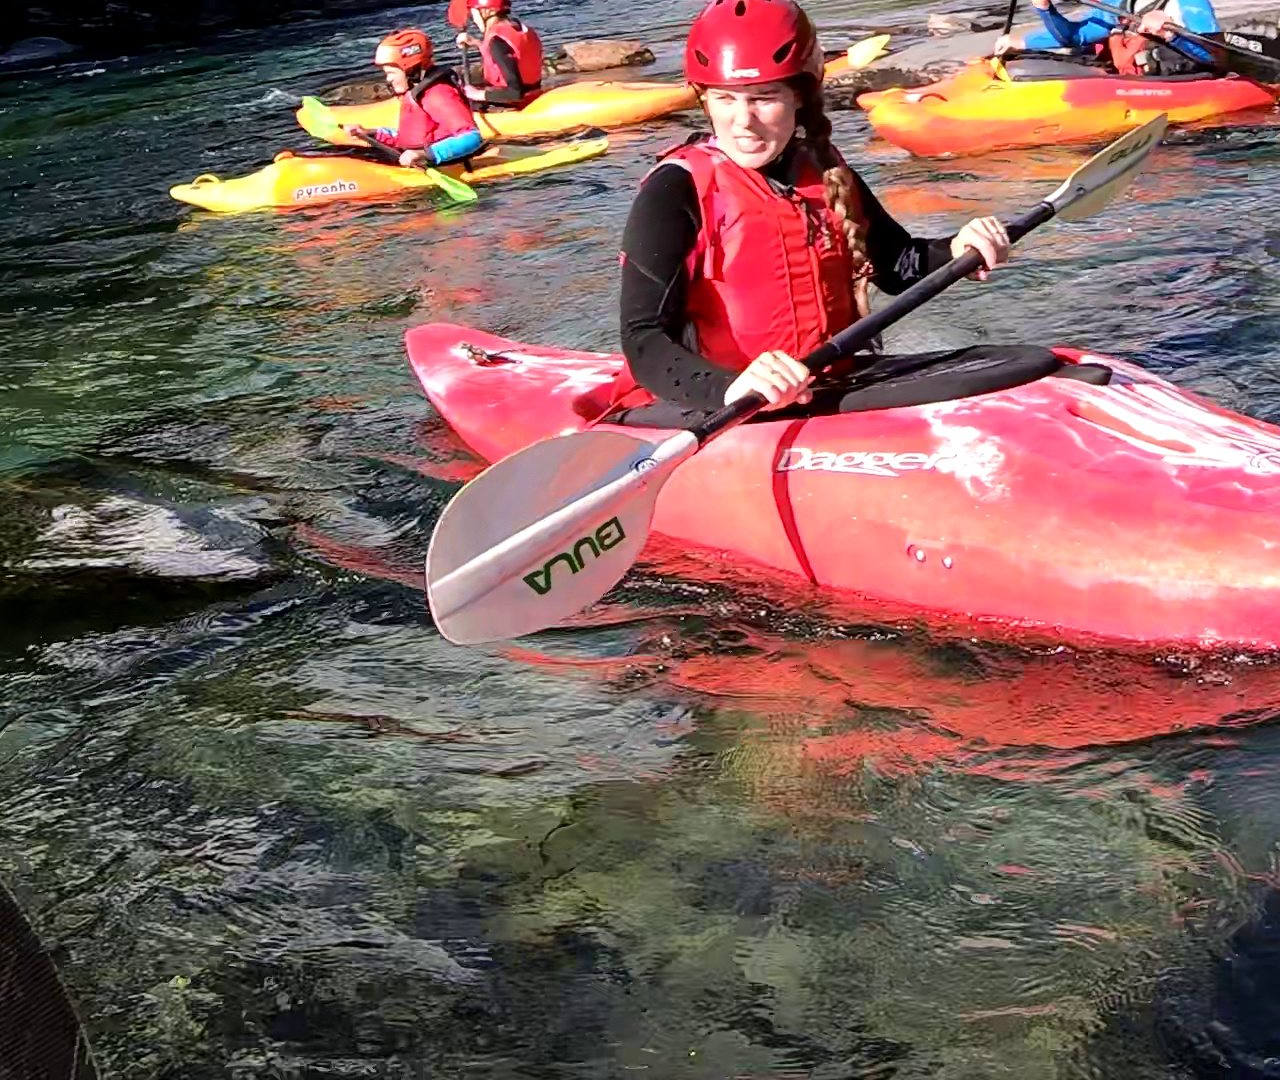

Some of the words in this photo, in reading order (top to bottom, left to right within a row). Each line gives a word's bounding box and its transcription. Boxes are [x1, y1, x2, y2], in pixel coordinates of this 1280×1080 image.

[295, 180, 358, 201] pyranha
[775, 447, 957, 478] Dagger
[522, 516, 627, 596] BULA
